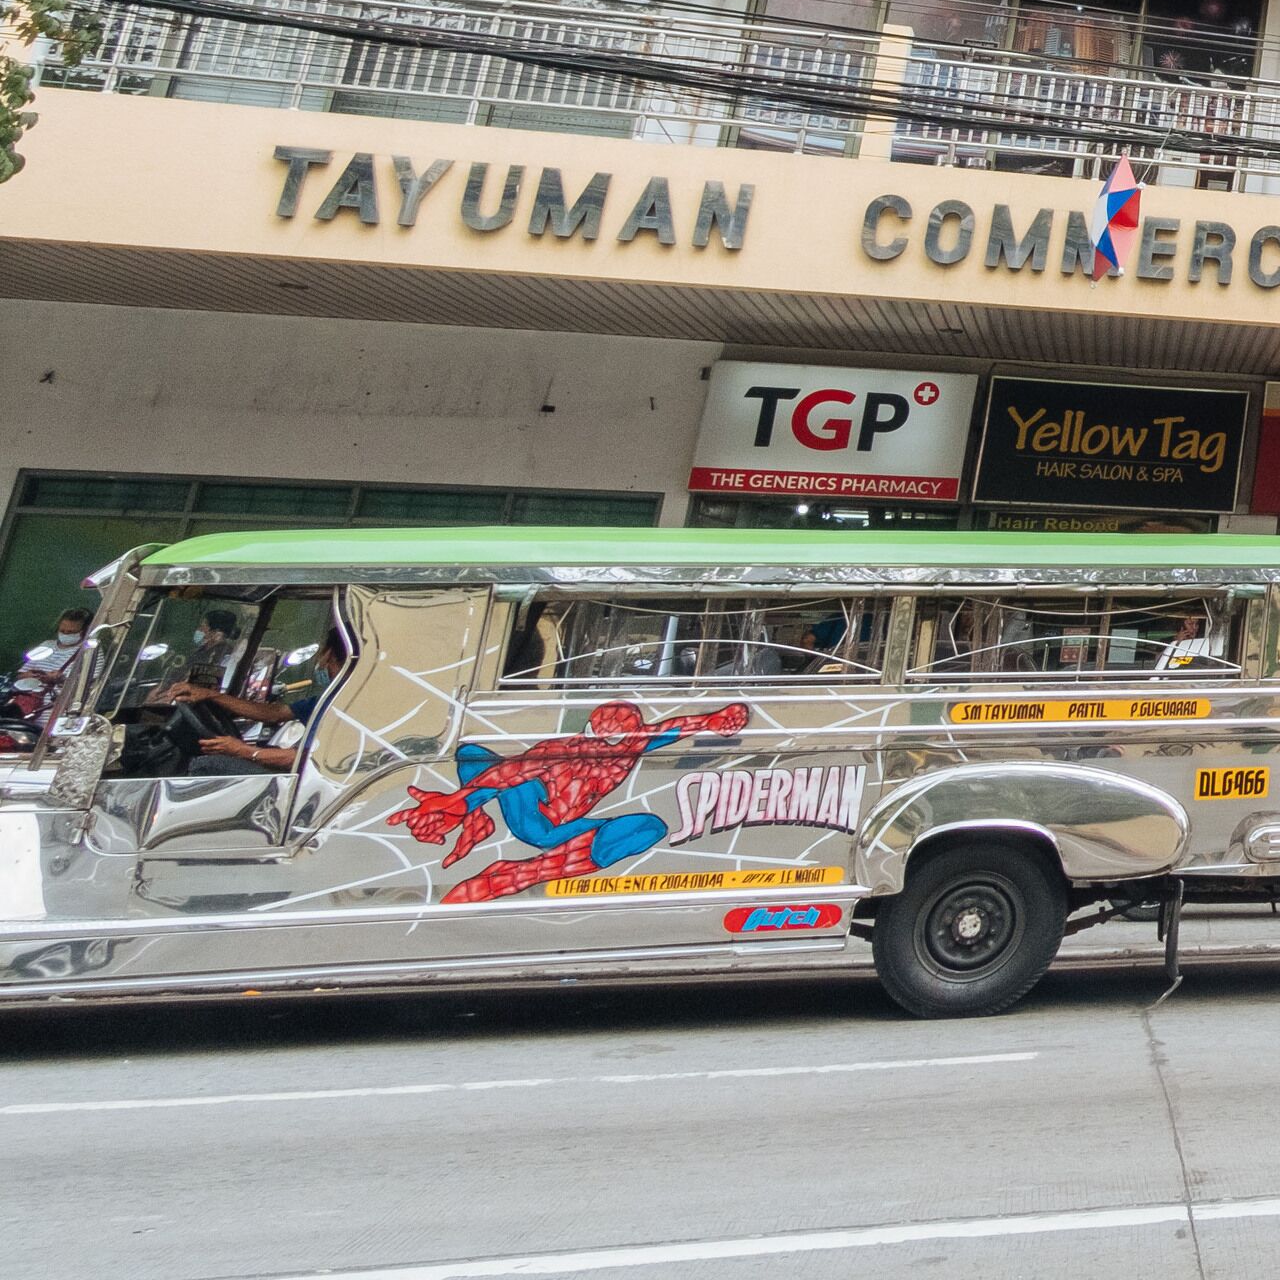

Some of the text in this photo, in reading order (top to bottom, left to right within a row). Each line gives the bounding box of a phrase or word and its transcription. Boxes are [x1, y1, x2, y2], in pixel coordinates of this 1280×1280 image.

[274, 145, 756, 251] TAYUMAN
[744, 386, 910, 452] TGP
[1007, 406, 1227, 473] Yellow Tag
[710, 472, 942, 495] THE GENERICS PHARMACY
[1036, 461, 1184, 483] HAIR SALON & SPA
[996, 516, 1038, 531] Hair
[961, 704, 982, 720] SM
[984, 703, 1046, 720] TAYUMAN
[1067, 702, 1107, 718] PRITIL
[669, 765, 868, 846] SPIDERMAN
[741, 907, 820, 931] Butch
